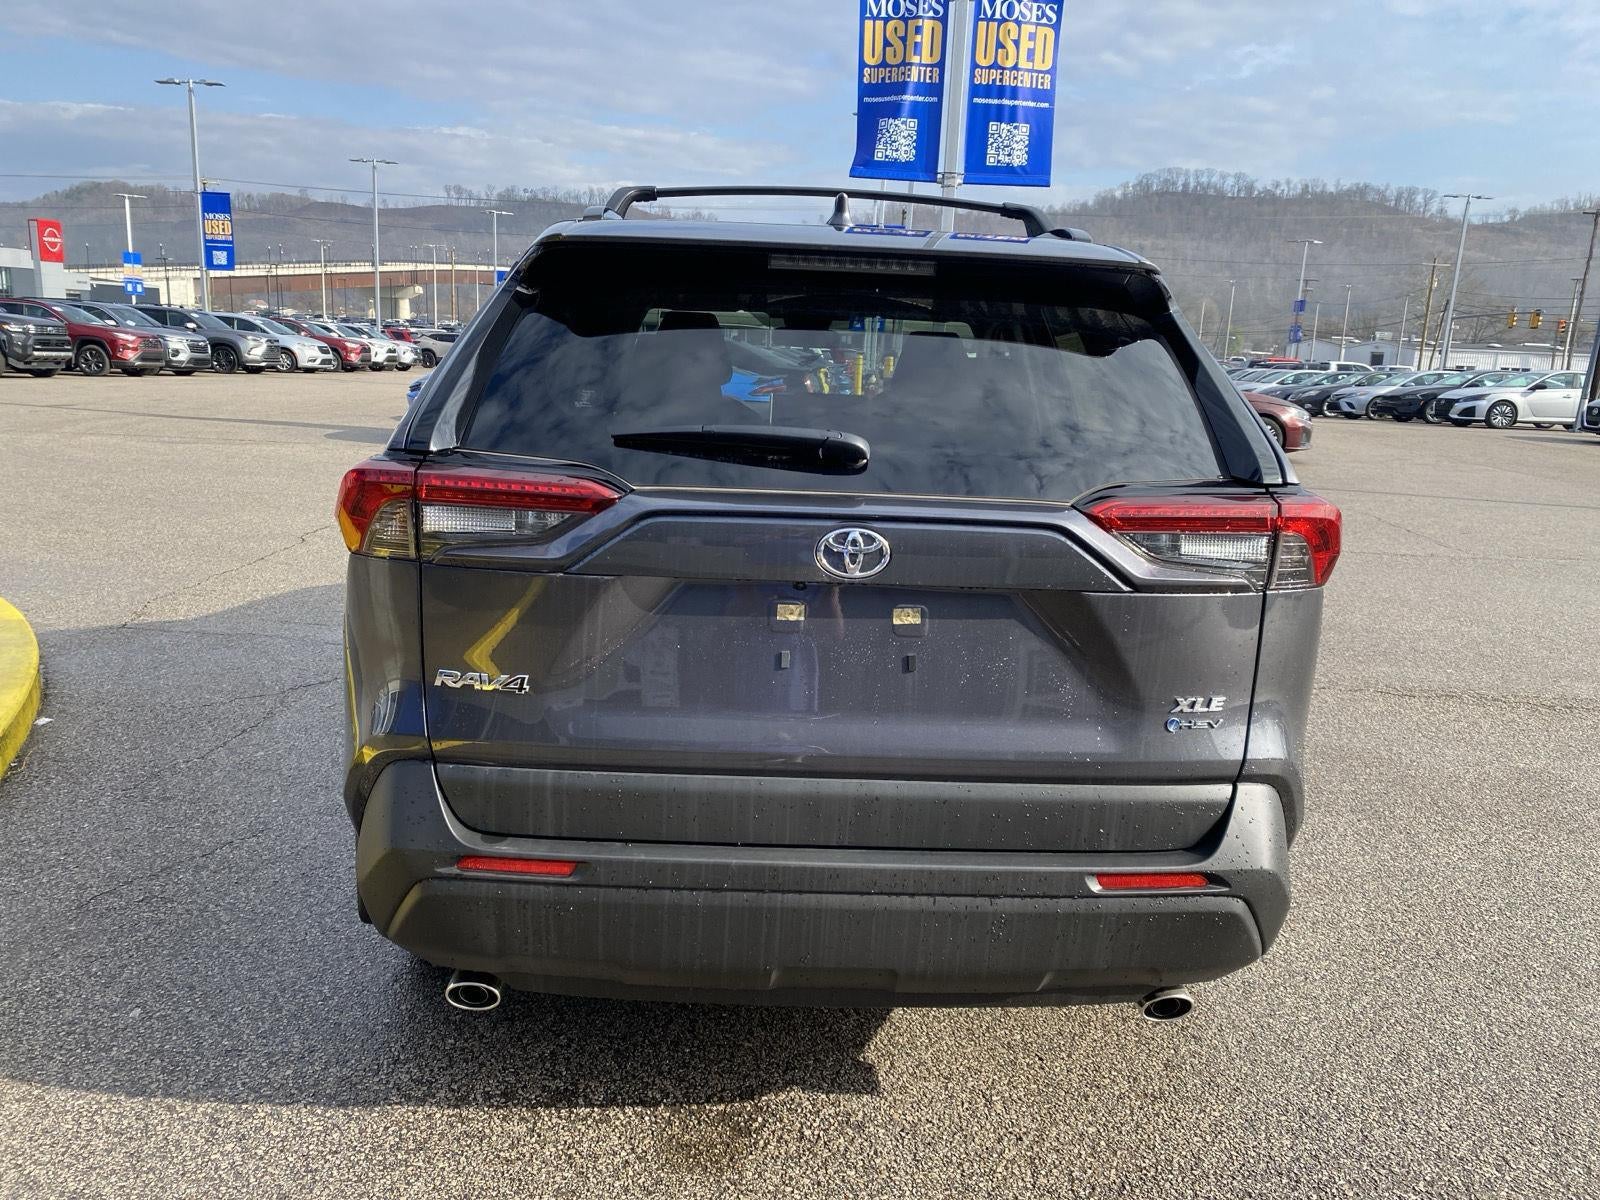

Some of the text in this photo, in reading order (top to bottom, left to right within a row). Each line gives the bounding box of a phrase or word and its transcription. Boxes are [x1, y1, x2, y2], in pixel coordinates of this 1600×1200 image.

[865, 0, 944, 18] MOSES
[979, 0, 1057, 24] MOSES
[863, 19, 943, 66] USED
[975, 21, 1055, 71] USED
[863, 66, 939, 84] SUPERCENTER
[974, 69, 1051, 90] SUPERCENTER
[863, 95, 938, 103] mosesusedsupercenter.com
[973, 97, 1050, 109] mosesusedsupercenter.com
[204, 212, 231, 220] MOSES
[205, 220, 232, 235] USED
[434, 669, 530, 695] RAV4
[1170, 696, 1227, 713] XLE
